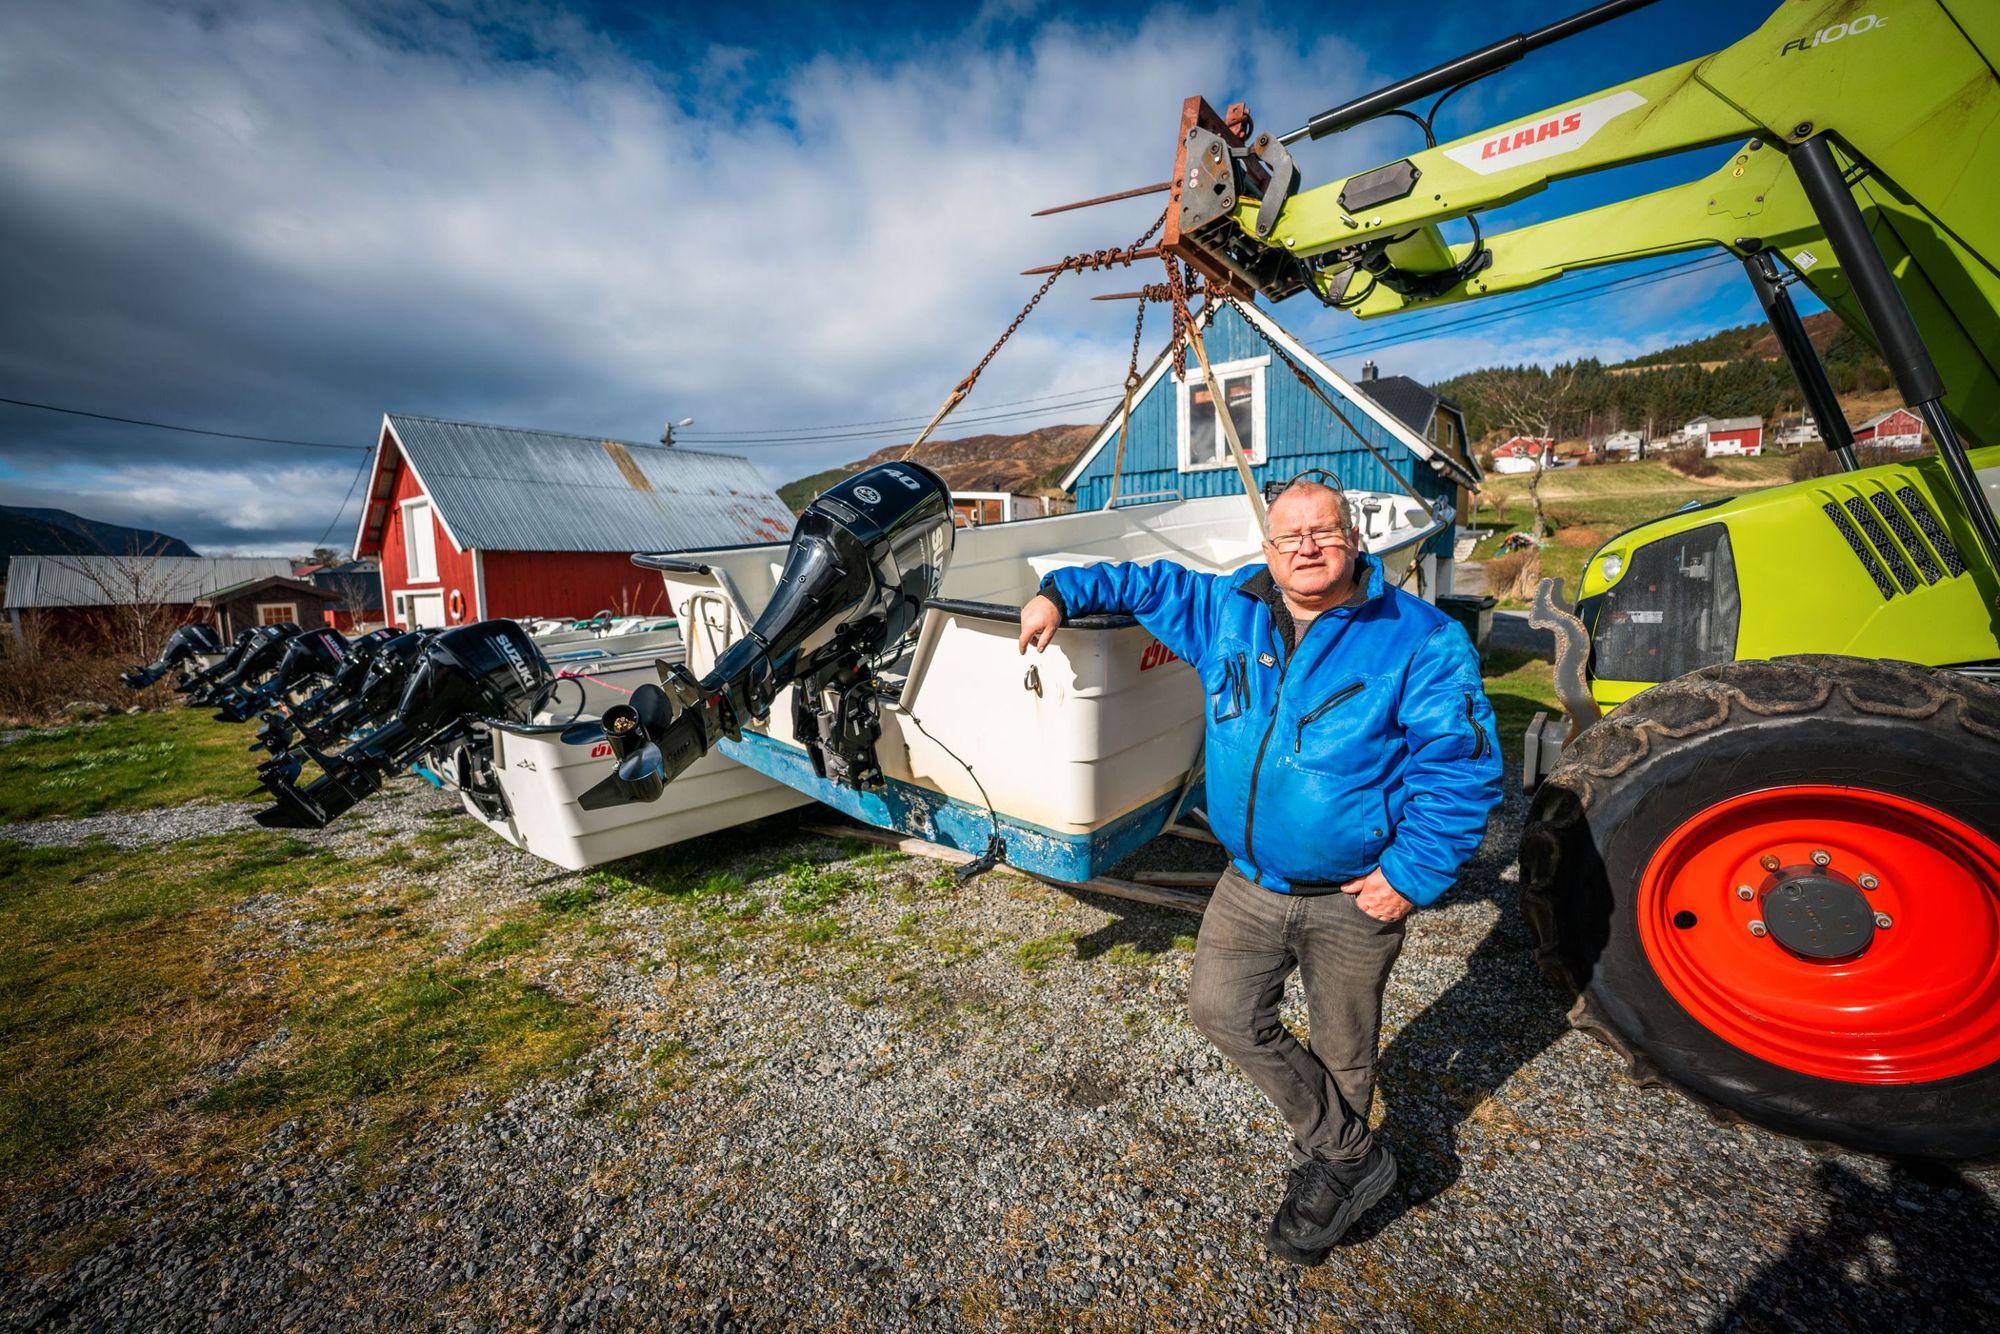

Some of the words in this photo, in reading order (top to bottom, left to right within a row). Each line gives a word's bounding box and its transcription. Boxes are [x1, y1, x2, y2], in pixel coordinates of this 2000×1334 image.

[1481, 112, 1581, 160] CLAAS
[881, 468, 921, 490] 40
[496, 634, 535, 687] SUZUKI
